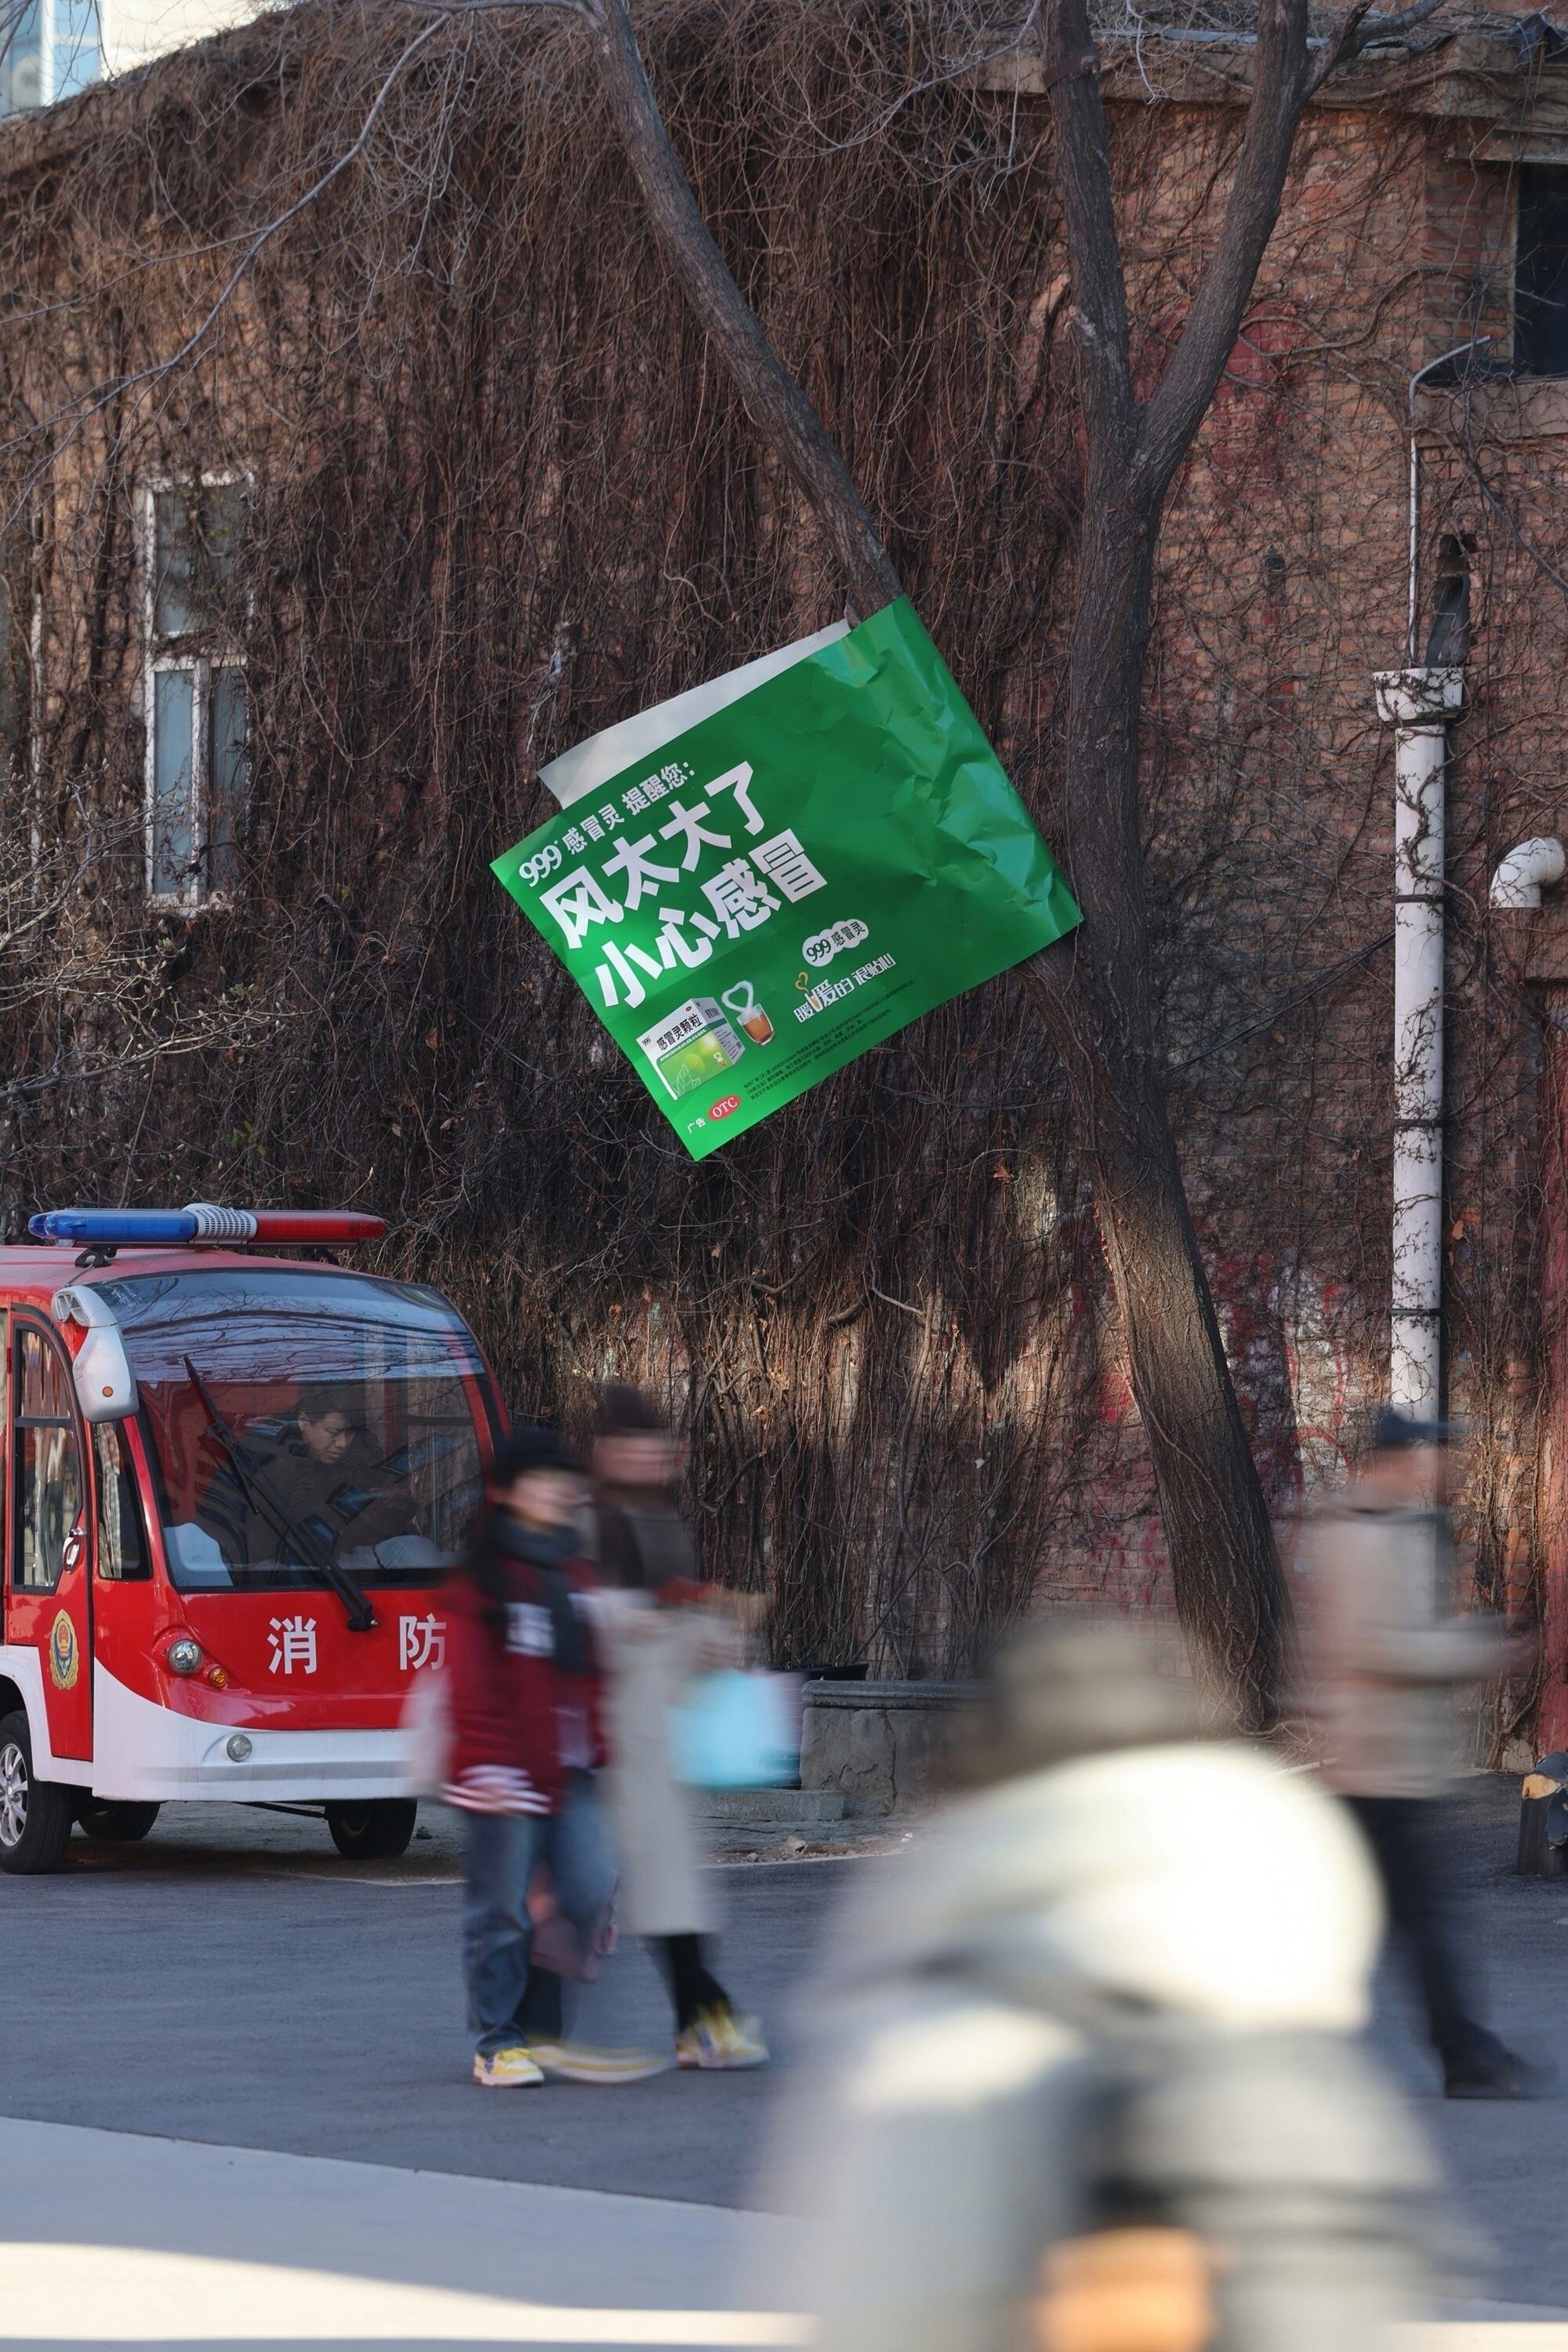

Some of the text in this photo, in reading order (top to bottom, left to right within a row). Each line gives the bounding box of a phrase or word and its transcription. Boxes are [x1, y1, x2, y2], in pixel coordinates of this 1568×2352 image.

[518, 844, 563, 887] 999
[562, 804, 625, 855] 感冒灵
[539, 760, 764, 949] 风太大了
[594, 828, 828, 1009] 小心感冒
[806, 920, 866, 963] 999 感冒灵
[656, 1013, 703, 1052] 感冒灵颗粒
[687, 1097, 739, 1134] 广告 OTC
